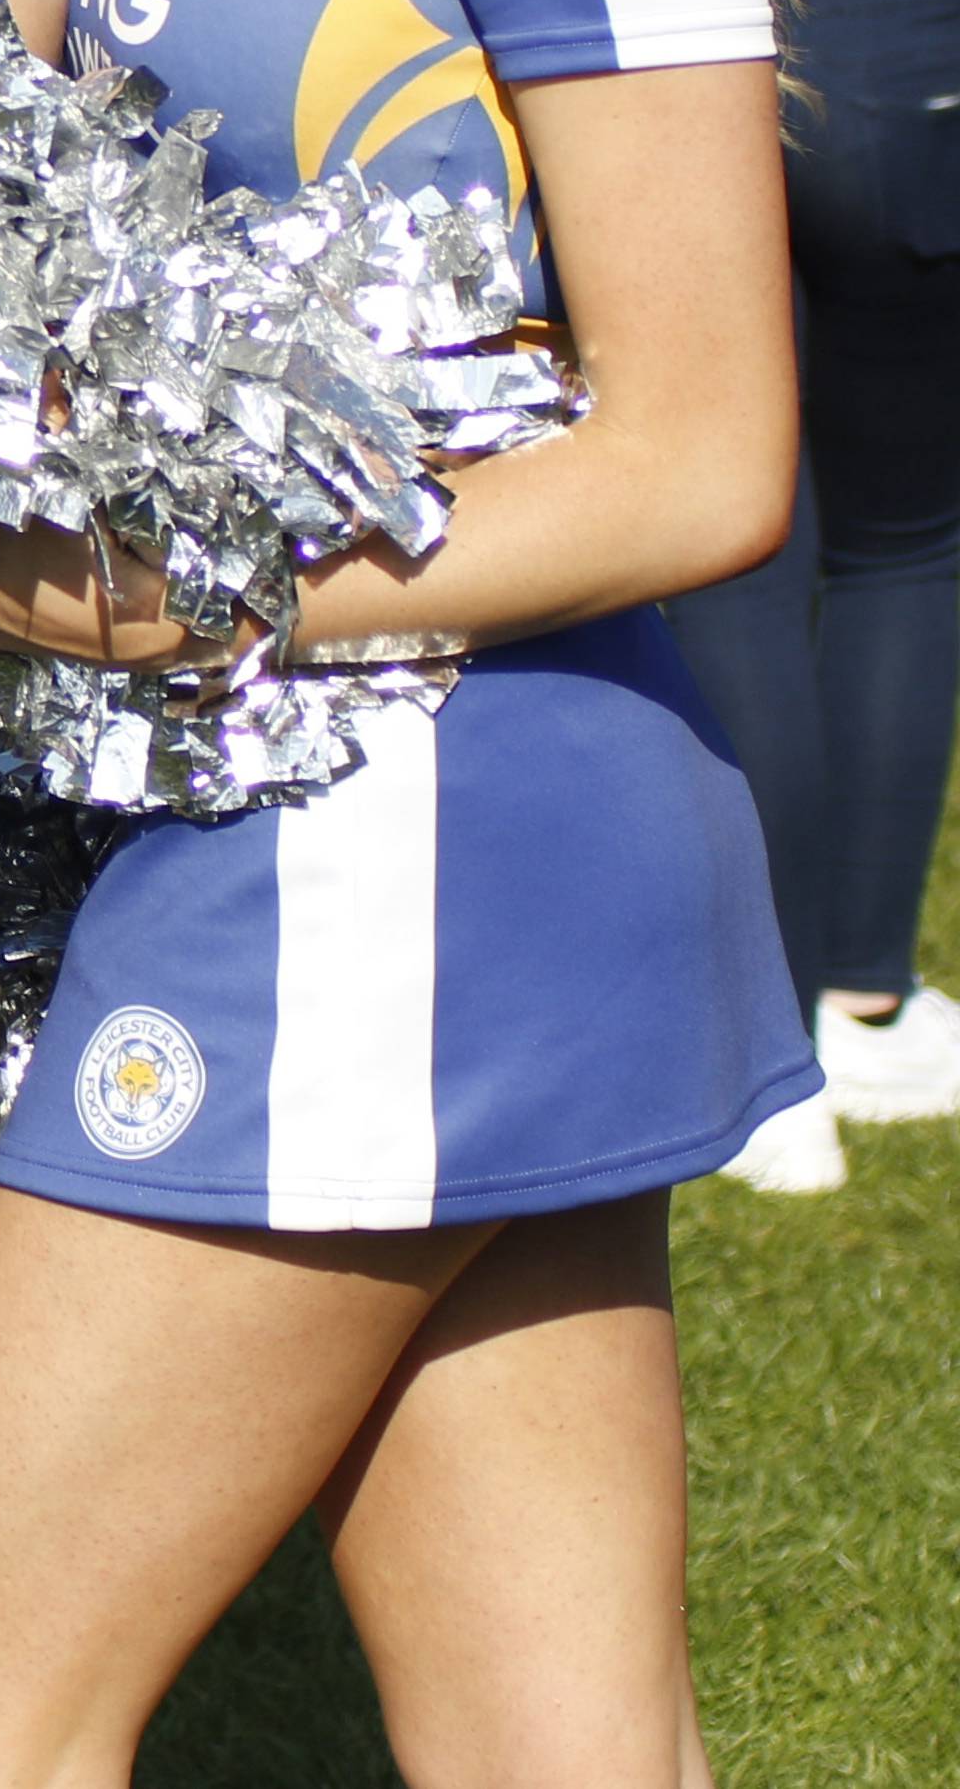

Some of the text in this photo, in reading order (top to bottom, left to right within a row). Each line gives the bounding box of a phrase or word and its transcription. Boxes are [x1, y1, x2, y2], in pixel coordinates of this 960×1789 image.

[92, 1019, 193, 1091] LEICESTER CITY
[85, 1077, 186, 1145] FOOTBALL CLUB
